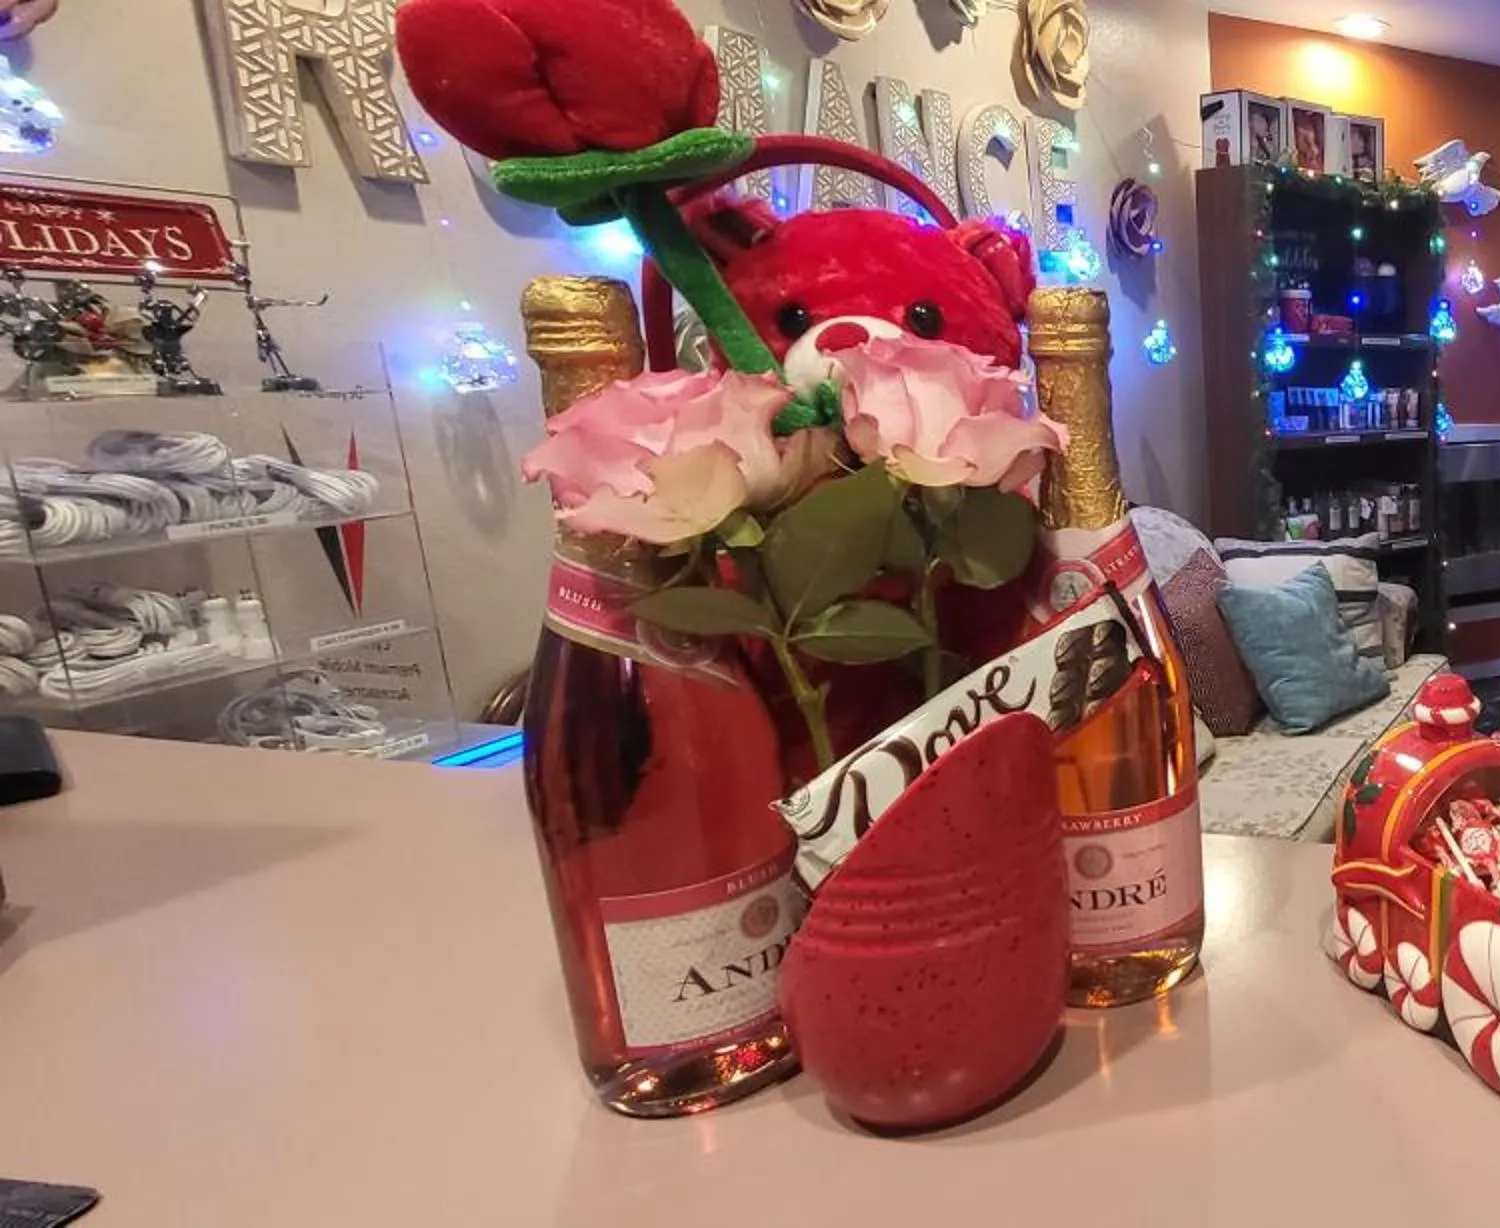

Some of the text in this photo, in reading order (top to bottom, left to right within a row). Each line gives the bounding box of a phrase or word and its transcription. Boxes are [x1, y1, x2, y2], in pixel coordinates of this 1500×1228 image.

[4, 201, 83, 221] HAPPY
[0, 219, 193, 262] LIDAYS
[558, 586, 602, 612] BLUSH
[799, 664, 1037, 841] Dove
[1069, 867, 1167, 911] NDRÉ
